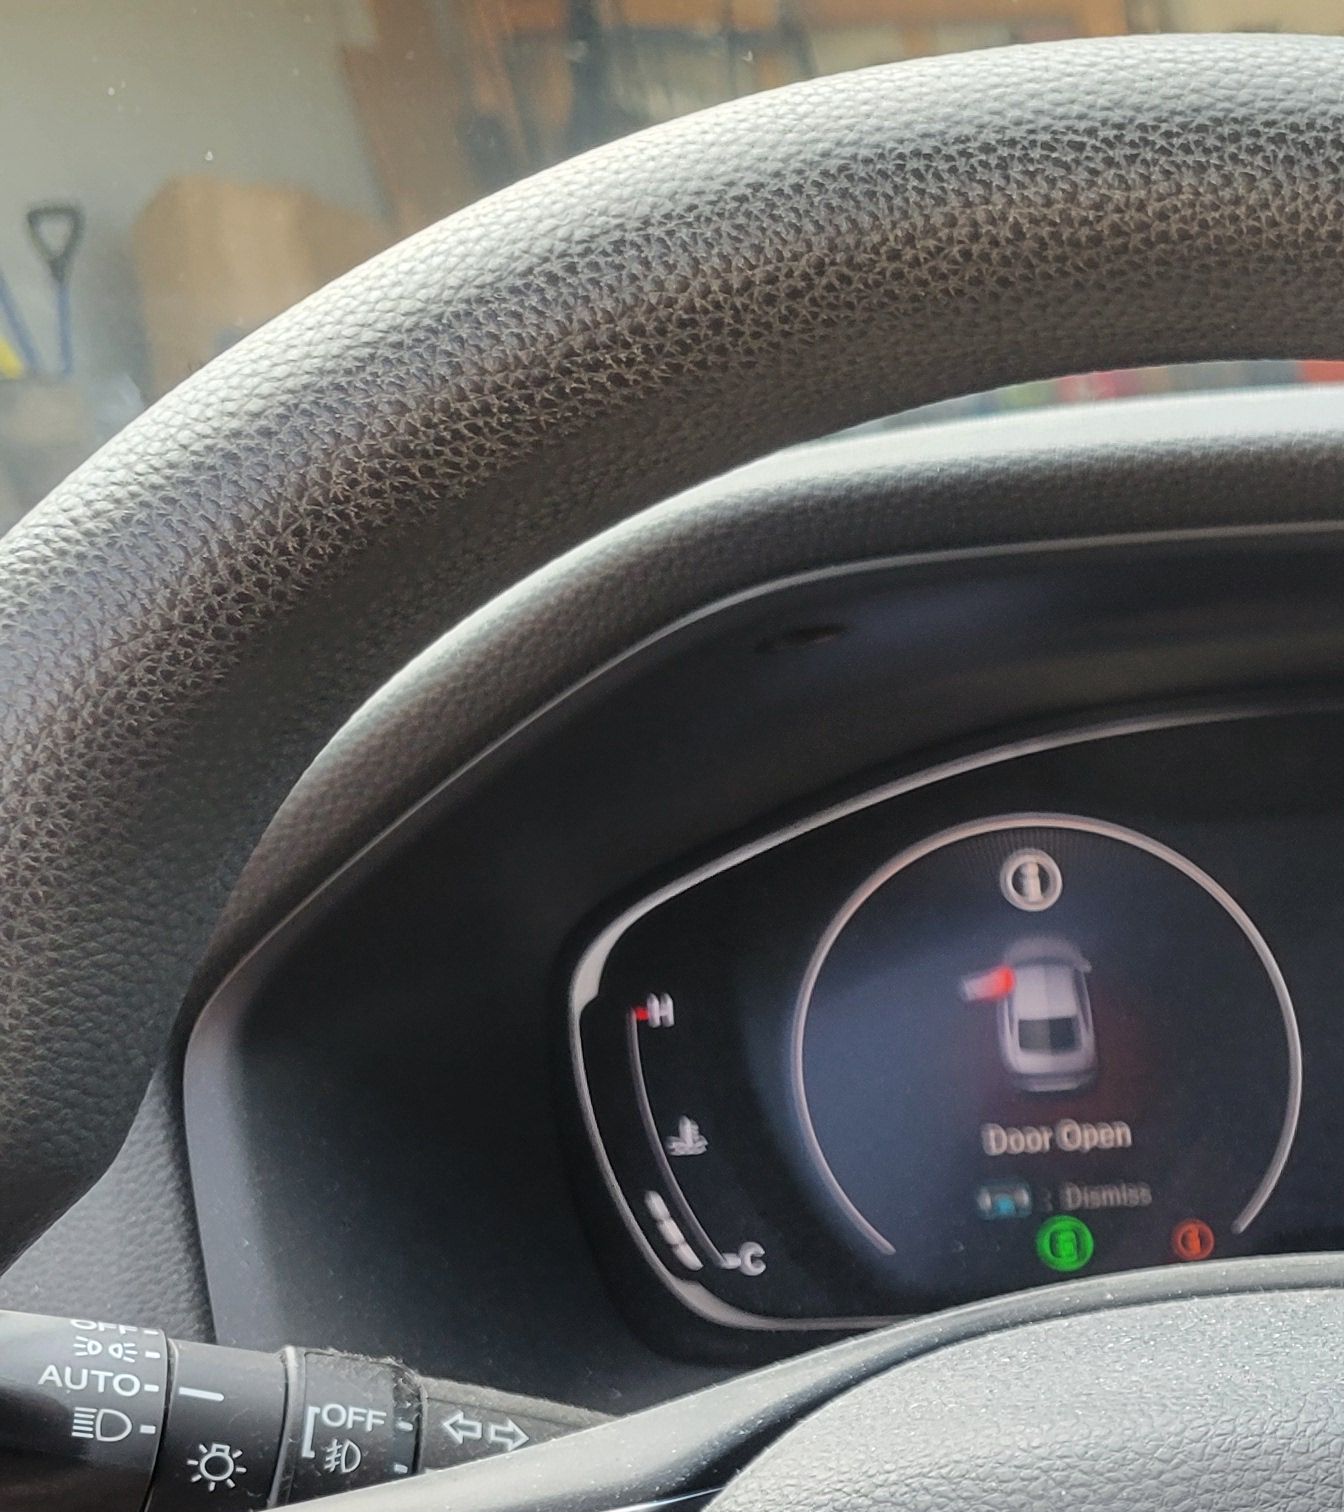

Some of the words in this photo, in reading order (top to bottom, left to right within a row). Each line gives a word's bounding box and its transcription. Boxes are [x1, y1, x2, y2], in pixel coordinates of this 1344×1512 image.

[982, 1122, 1052, 1156] Door
[1055, 1118, 1132, 1152] Open
[39, 1364, 141, 1397] AUTO
[322, 1403, 388, 1432] OFF
